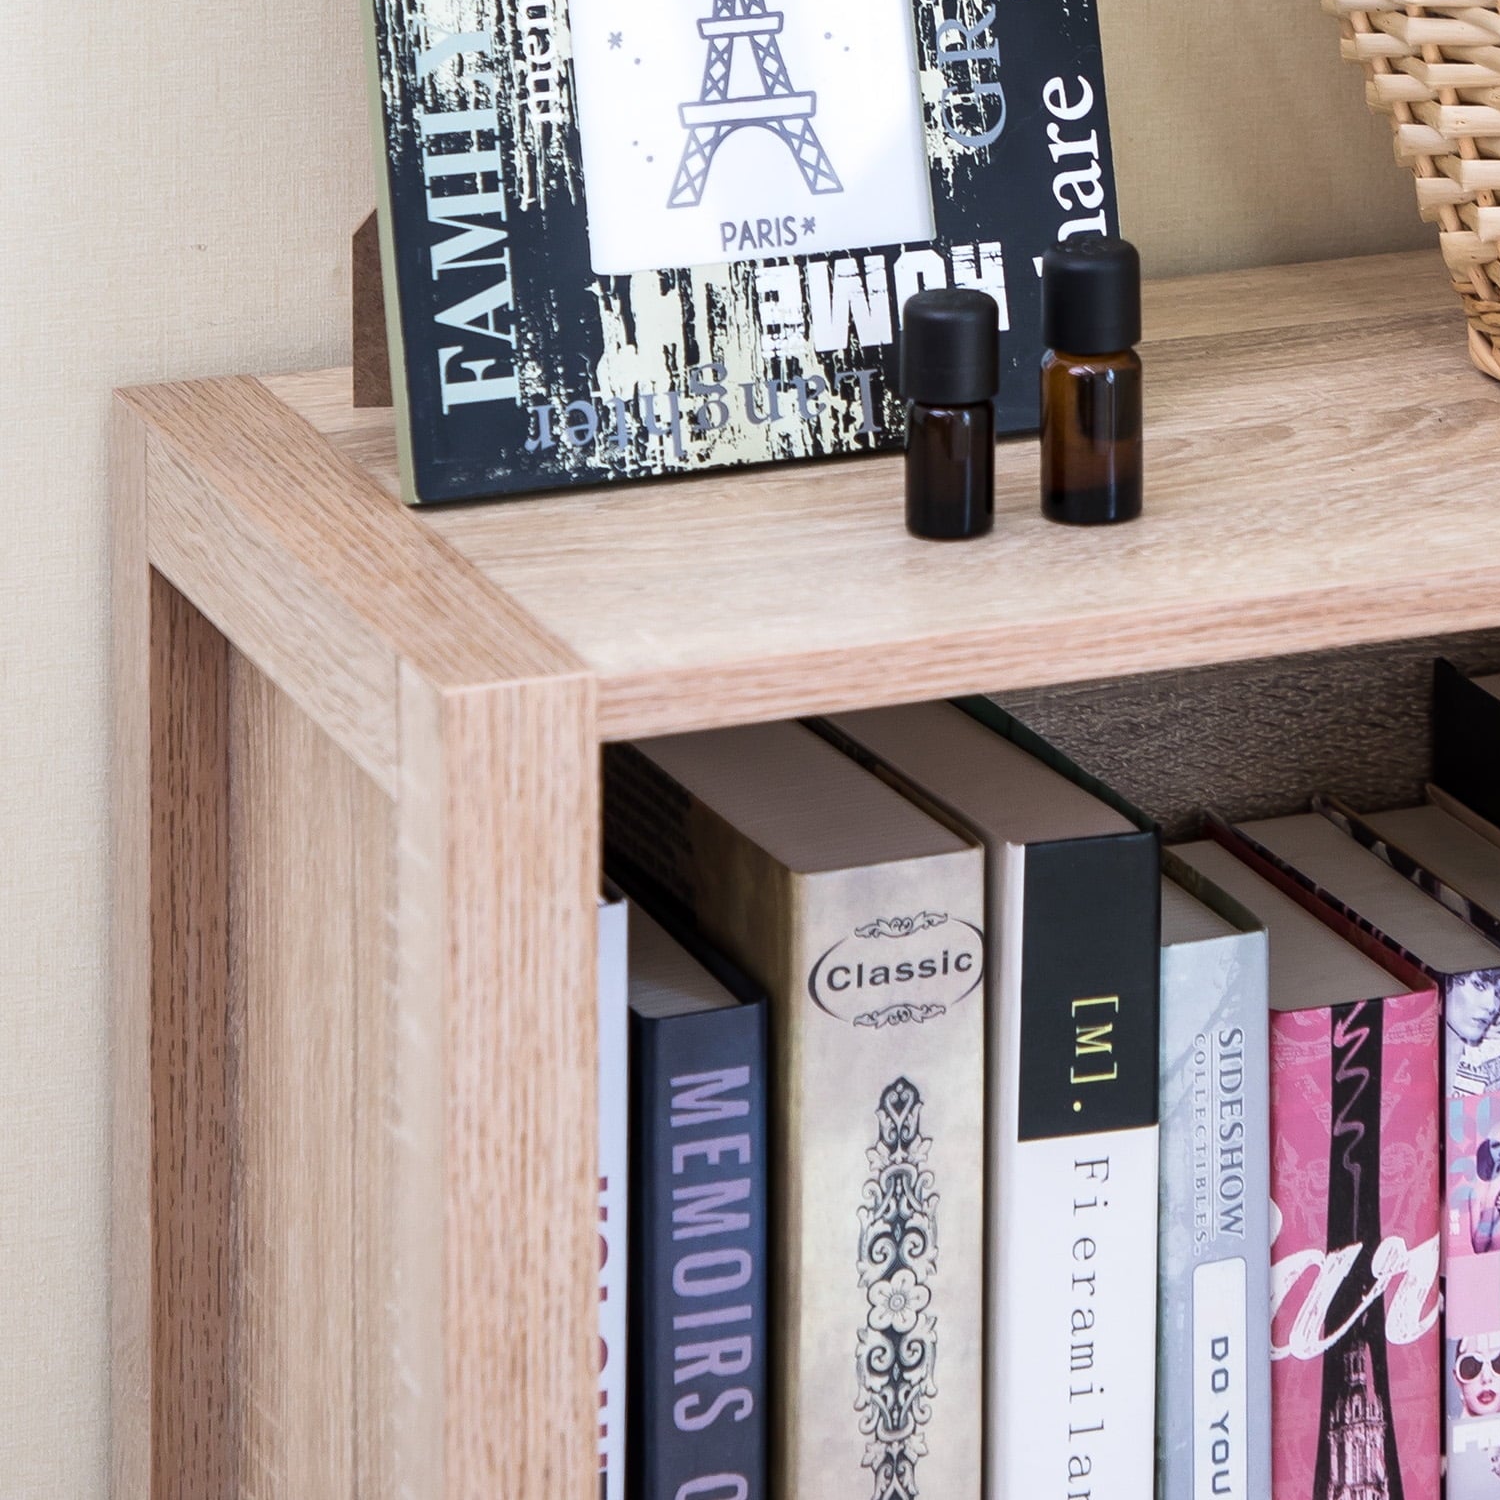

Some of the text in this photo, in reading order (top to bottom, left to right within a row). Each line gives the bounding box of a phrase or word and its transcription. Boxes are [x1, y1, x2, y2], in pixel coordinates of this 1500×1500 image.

[412, 15, 521, 416] FAMILY
[1032, 75, 1107, 277] are
[827, 950, 973, 992] Classic
[1193, 1032, 1208, 1245] COLLECTIBLES
[1218, 1027, 1246, 1240] SIDESHOW
[670, 1066, 754, 1431] MEMOIRS
[1210, 1336, 1231, 1495] DO YOU
